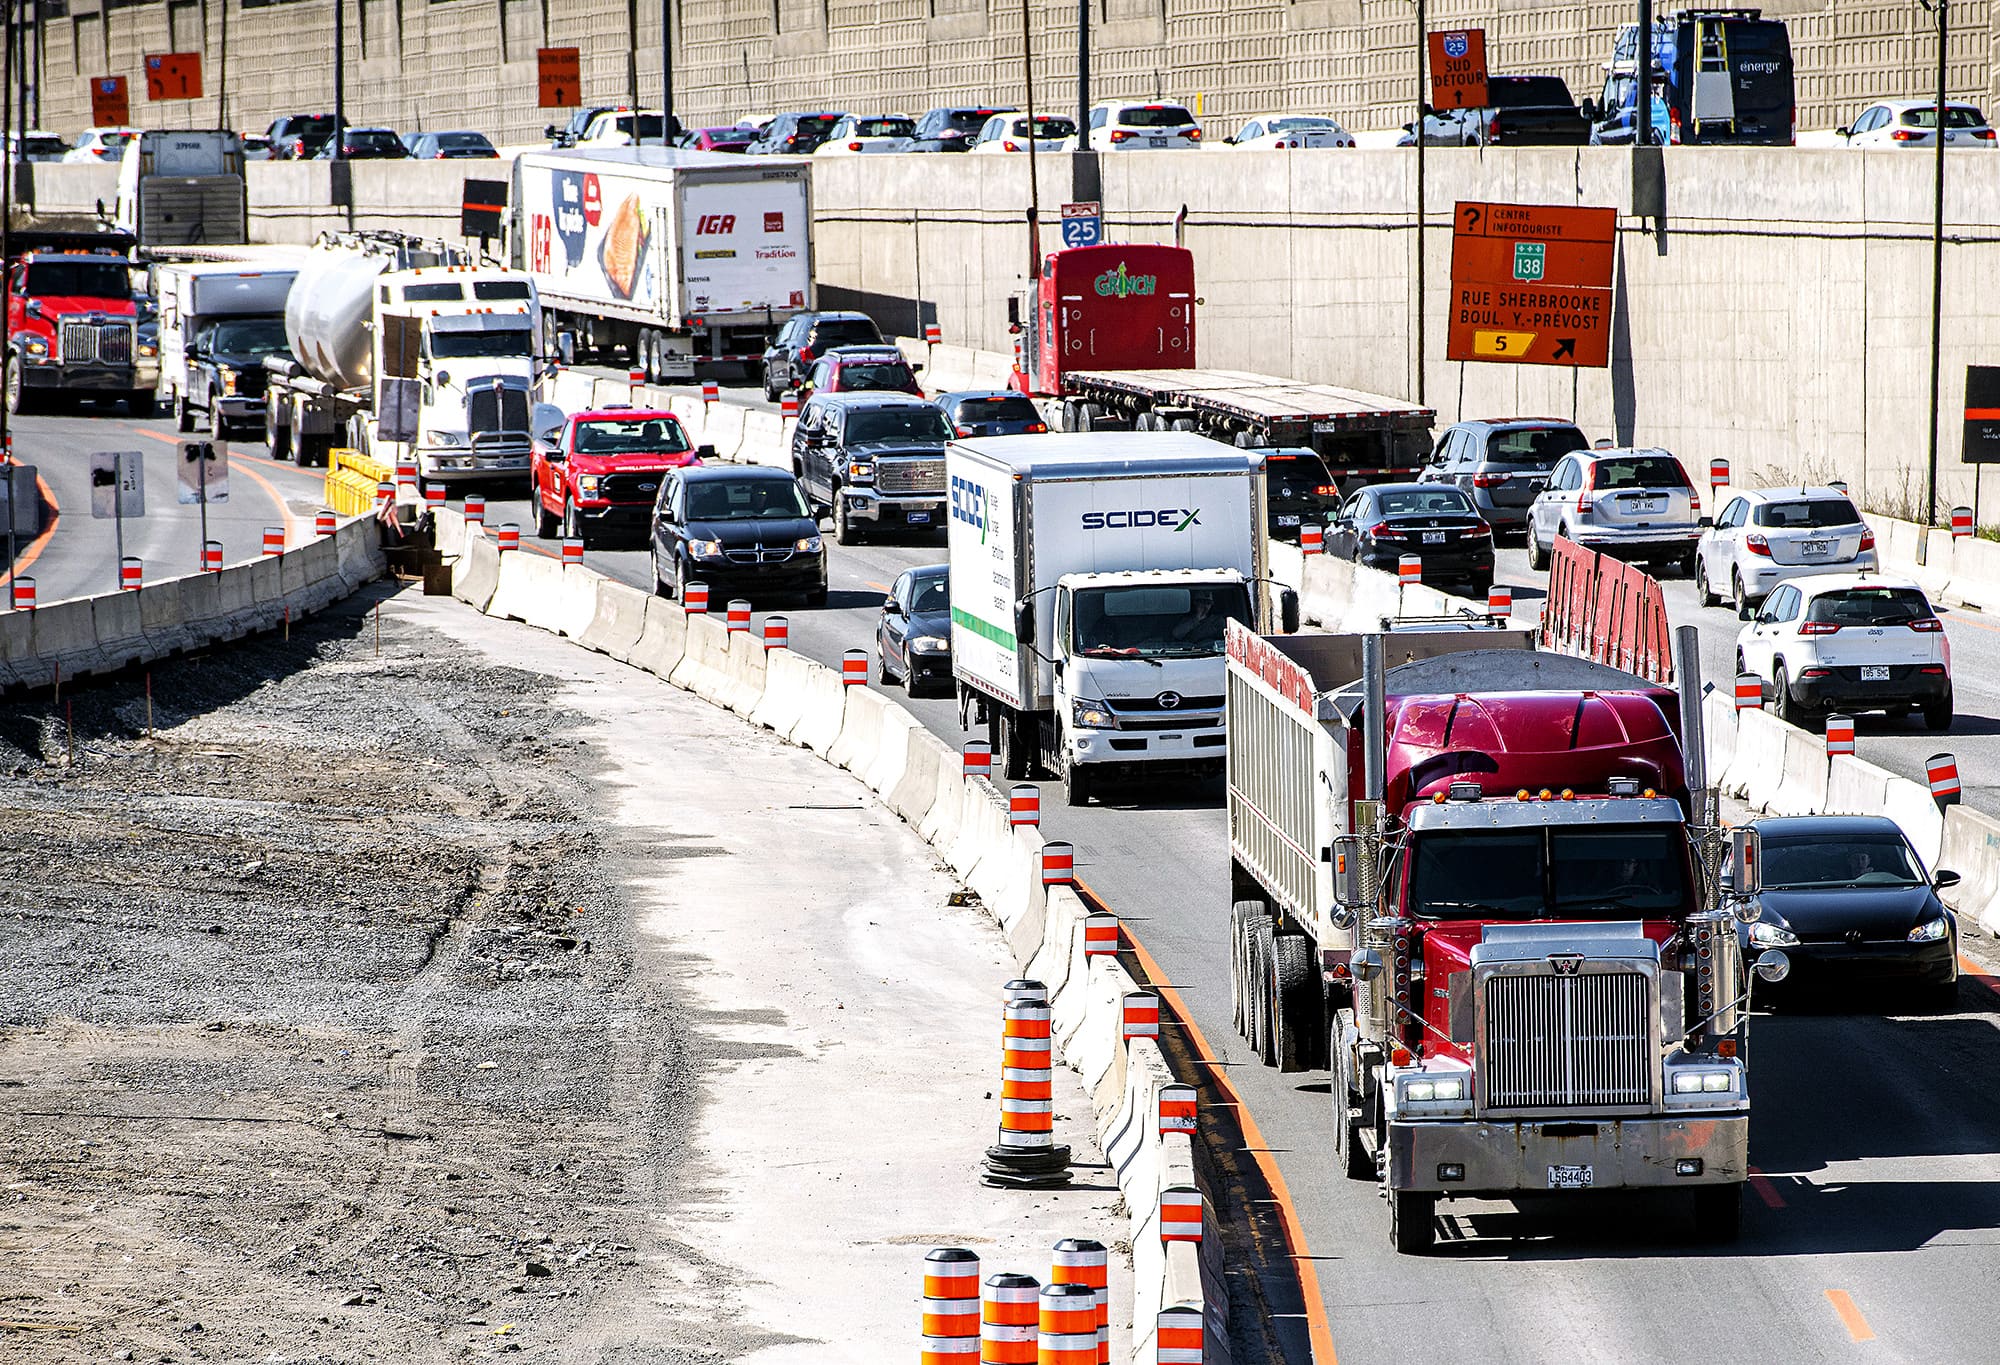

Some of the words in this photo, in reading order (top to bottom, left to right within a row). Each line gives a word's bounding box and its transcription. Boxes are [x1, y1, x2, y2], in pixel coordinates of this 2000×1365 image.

[1449, 42, 1465, 52] 25
[1445, 59, 1471, 73] SUD
[1493, 209, 1531, 220] CENTRE
[696, 214, 736, 235] IGA
[1068, 221, 1096, 241] 25
[1493, 223, 1563, 236] INFOTOURISTE
[531, 213, 551, 275] IGA
[755, 249, 796, 259] Tradition
[1518, 258, 1541, 275] 138
[1095, 273, 1156, 297] GRINCH
[1461, 291, 1491, 306] RUE
[1499, 292, 1600, 311] SHERBROOKE
[1460, 310, 1504, 326] BOUL.
[1513, 311, 1599, 330] Y.-PRÉVOST
[1495, 336, 1507, 351] 5
[1082, 508, 1202, 532] SCIDEX
[1549, 1171, 1592, 1183] L564403
